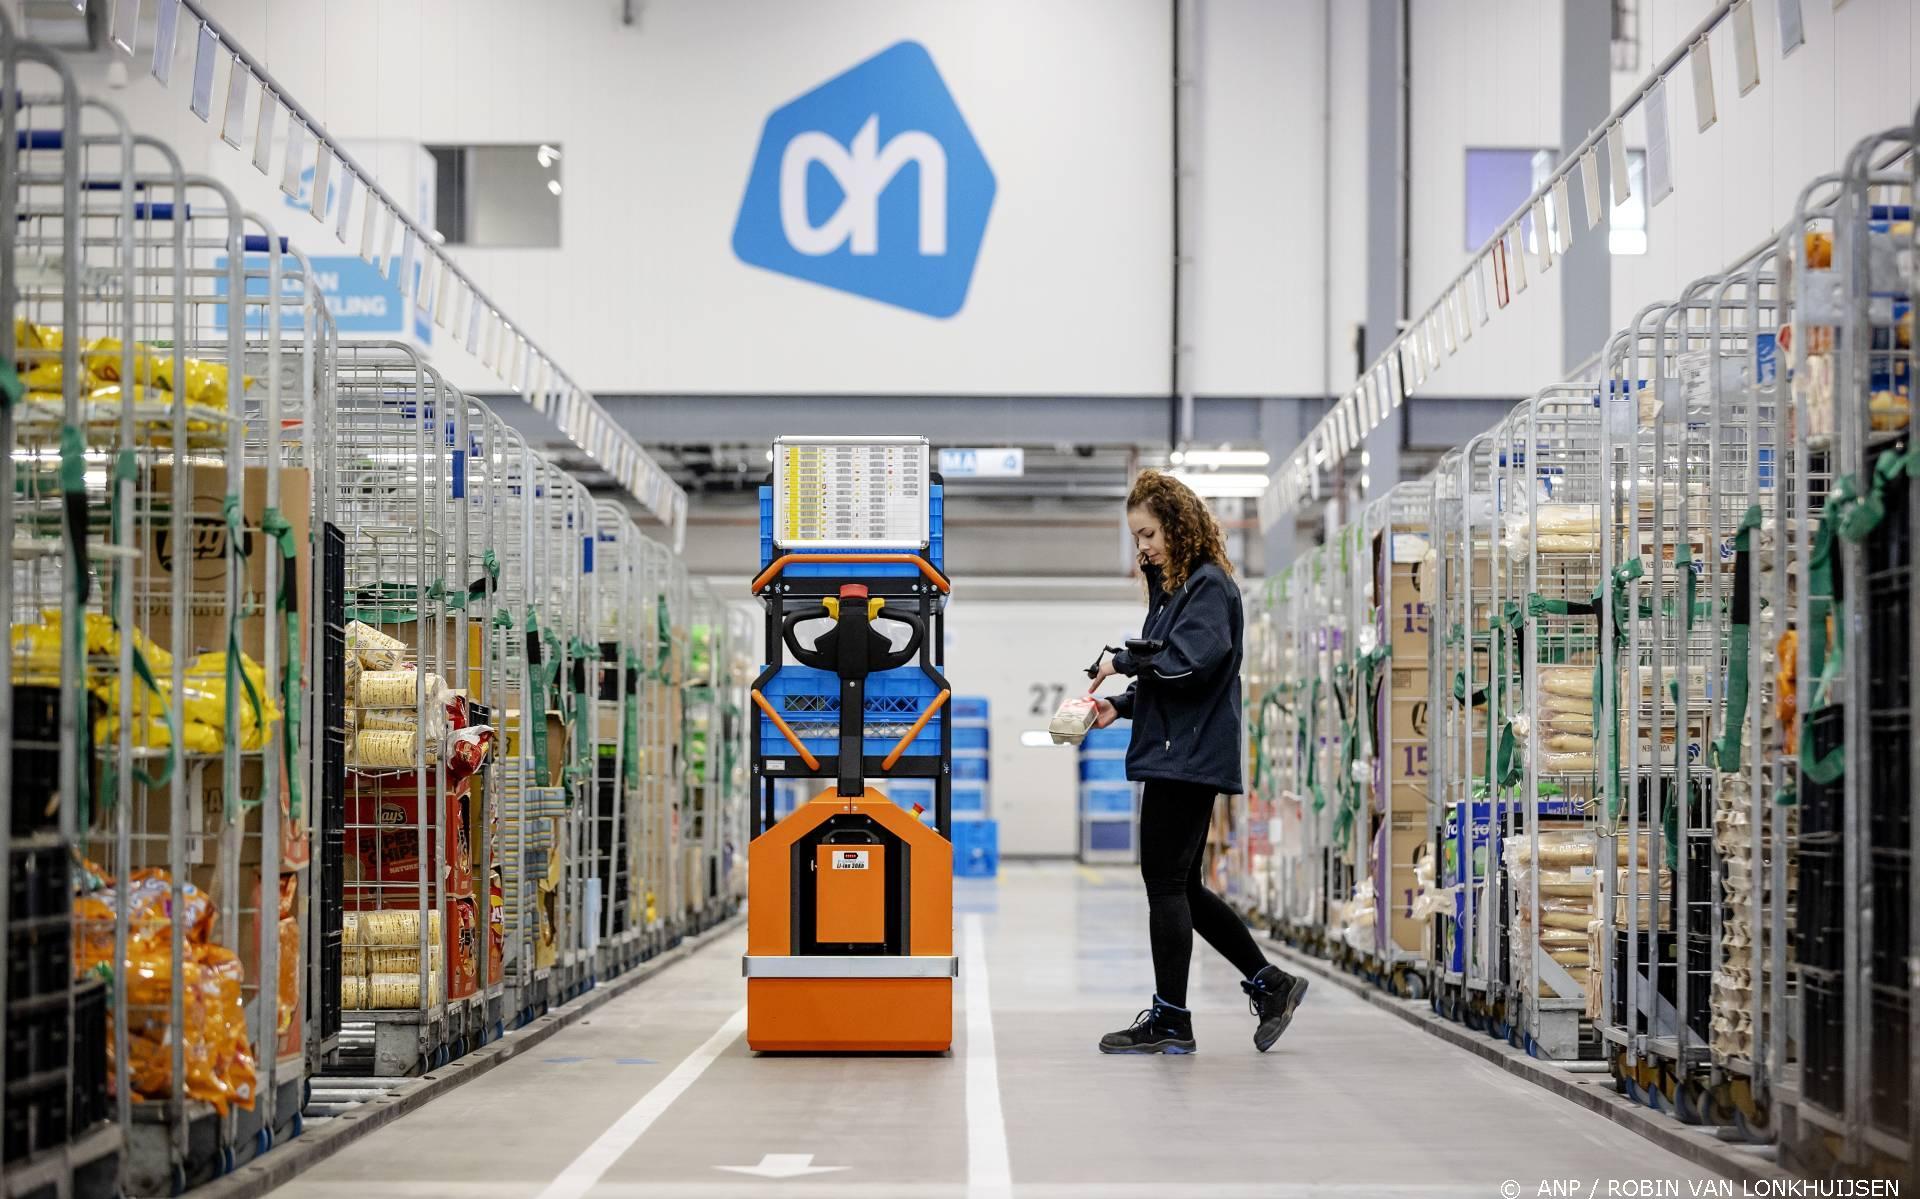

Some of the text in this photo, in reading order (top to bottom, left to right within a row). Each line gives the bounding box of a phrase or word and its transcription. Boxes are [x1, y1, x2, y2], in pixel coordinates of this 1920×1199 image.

[1645, 561, 1674, 569] VOLEN
[1403, 603, 1428, 633] 15
[1029, 683, 1065, 716] 27
[1403, 745, 1428, 777] 15
[1641, 744, 1671, 753] VOLEN
[389, 862, 420, 874] NATURE
[1403, 889, 1425, 919] 1
